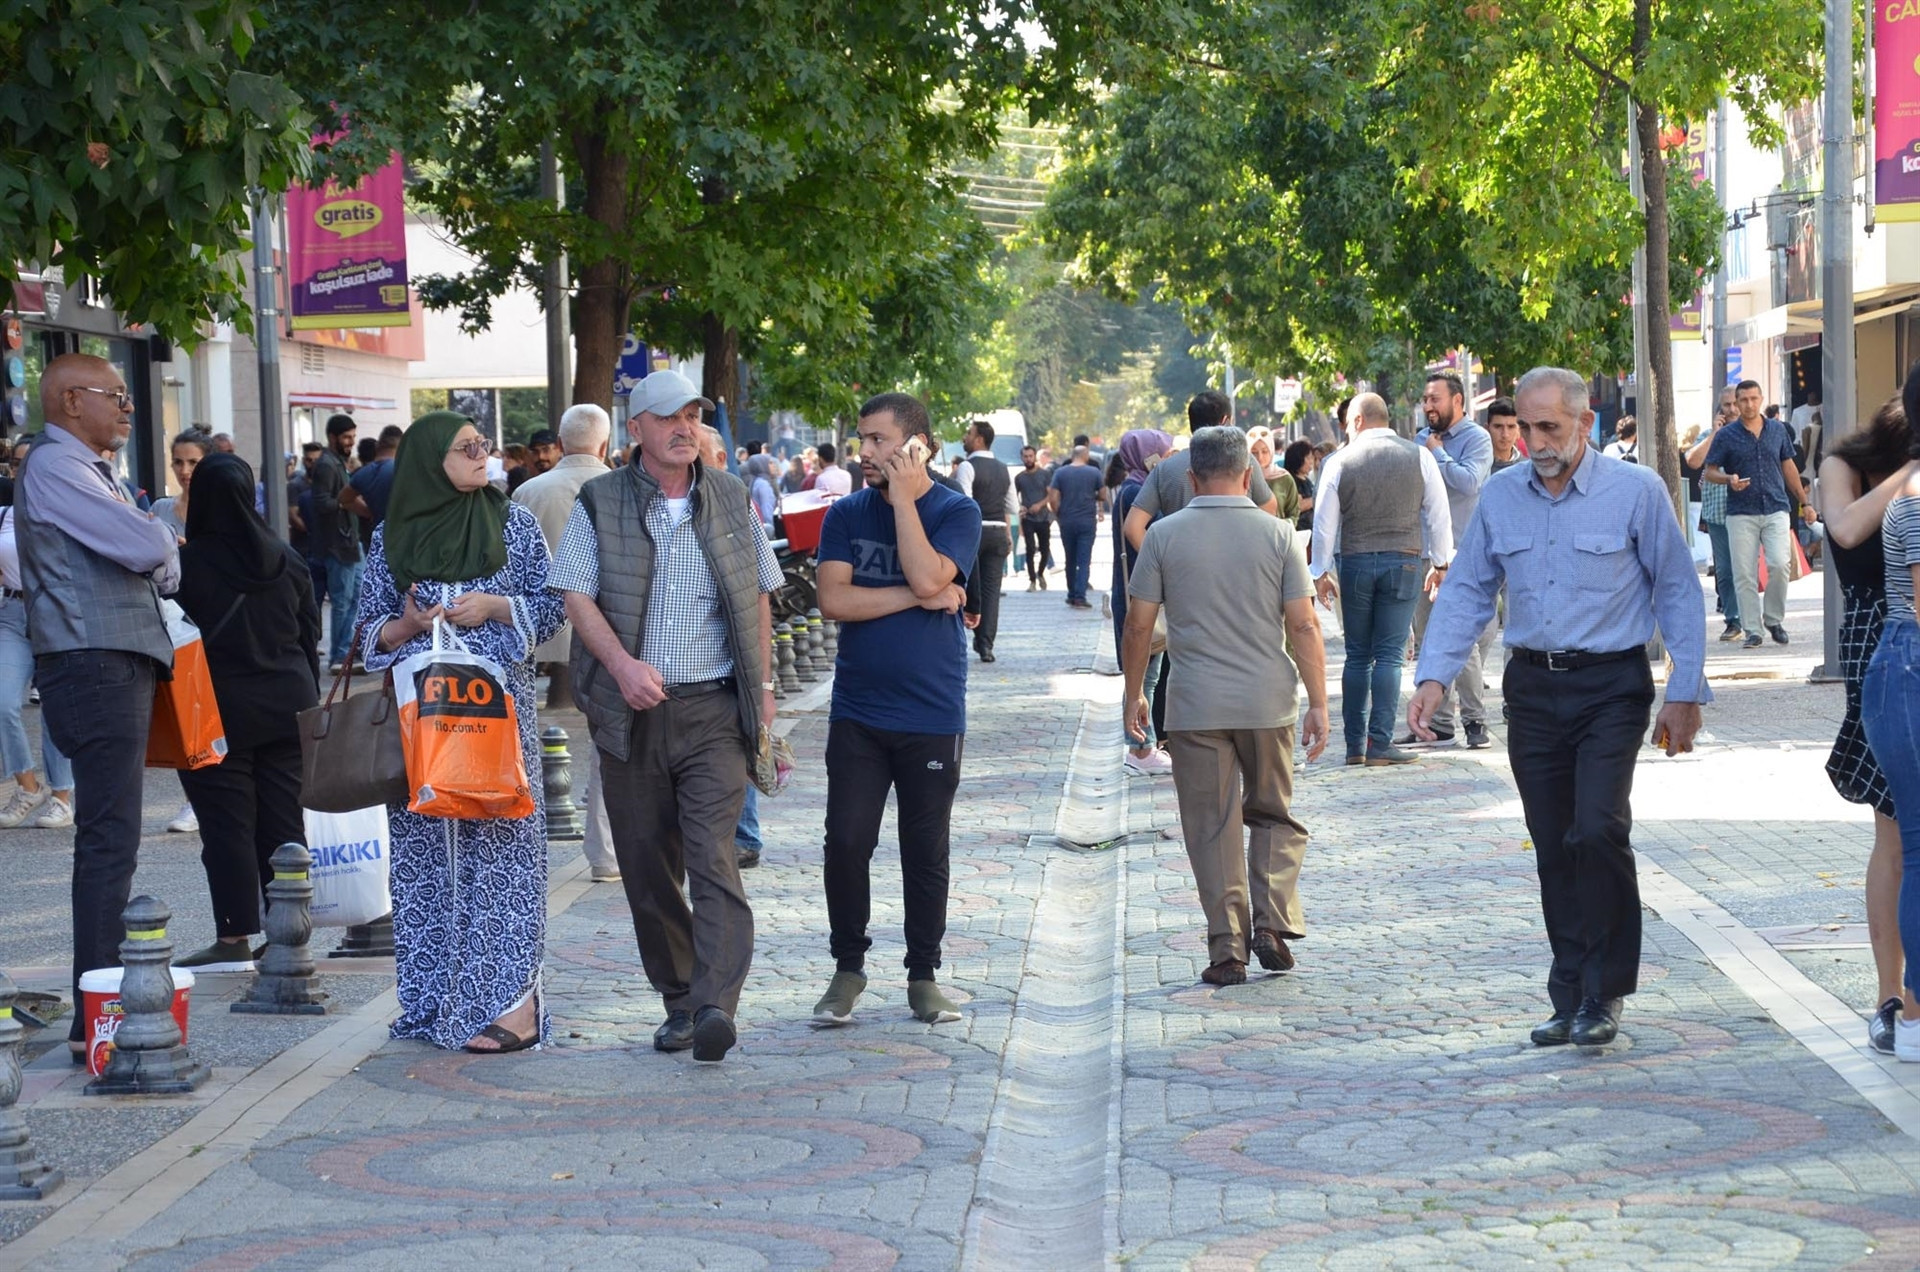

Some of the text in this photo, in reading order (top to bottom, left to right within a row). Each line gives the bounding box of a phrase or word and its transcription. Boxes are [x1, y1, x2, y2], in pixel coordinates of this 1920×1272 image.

[1886, 0, 1920, 22] CA
[322, 204, 375, 226] gratis
[309, 266, 394, 294] koşulsuz iade
[423, 676, 493, 705] FLO
[434, 720, 487, 733] flo.com.tr
